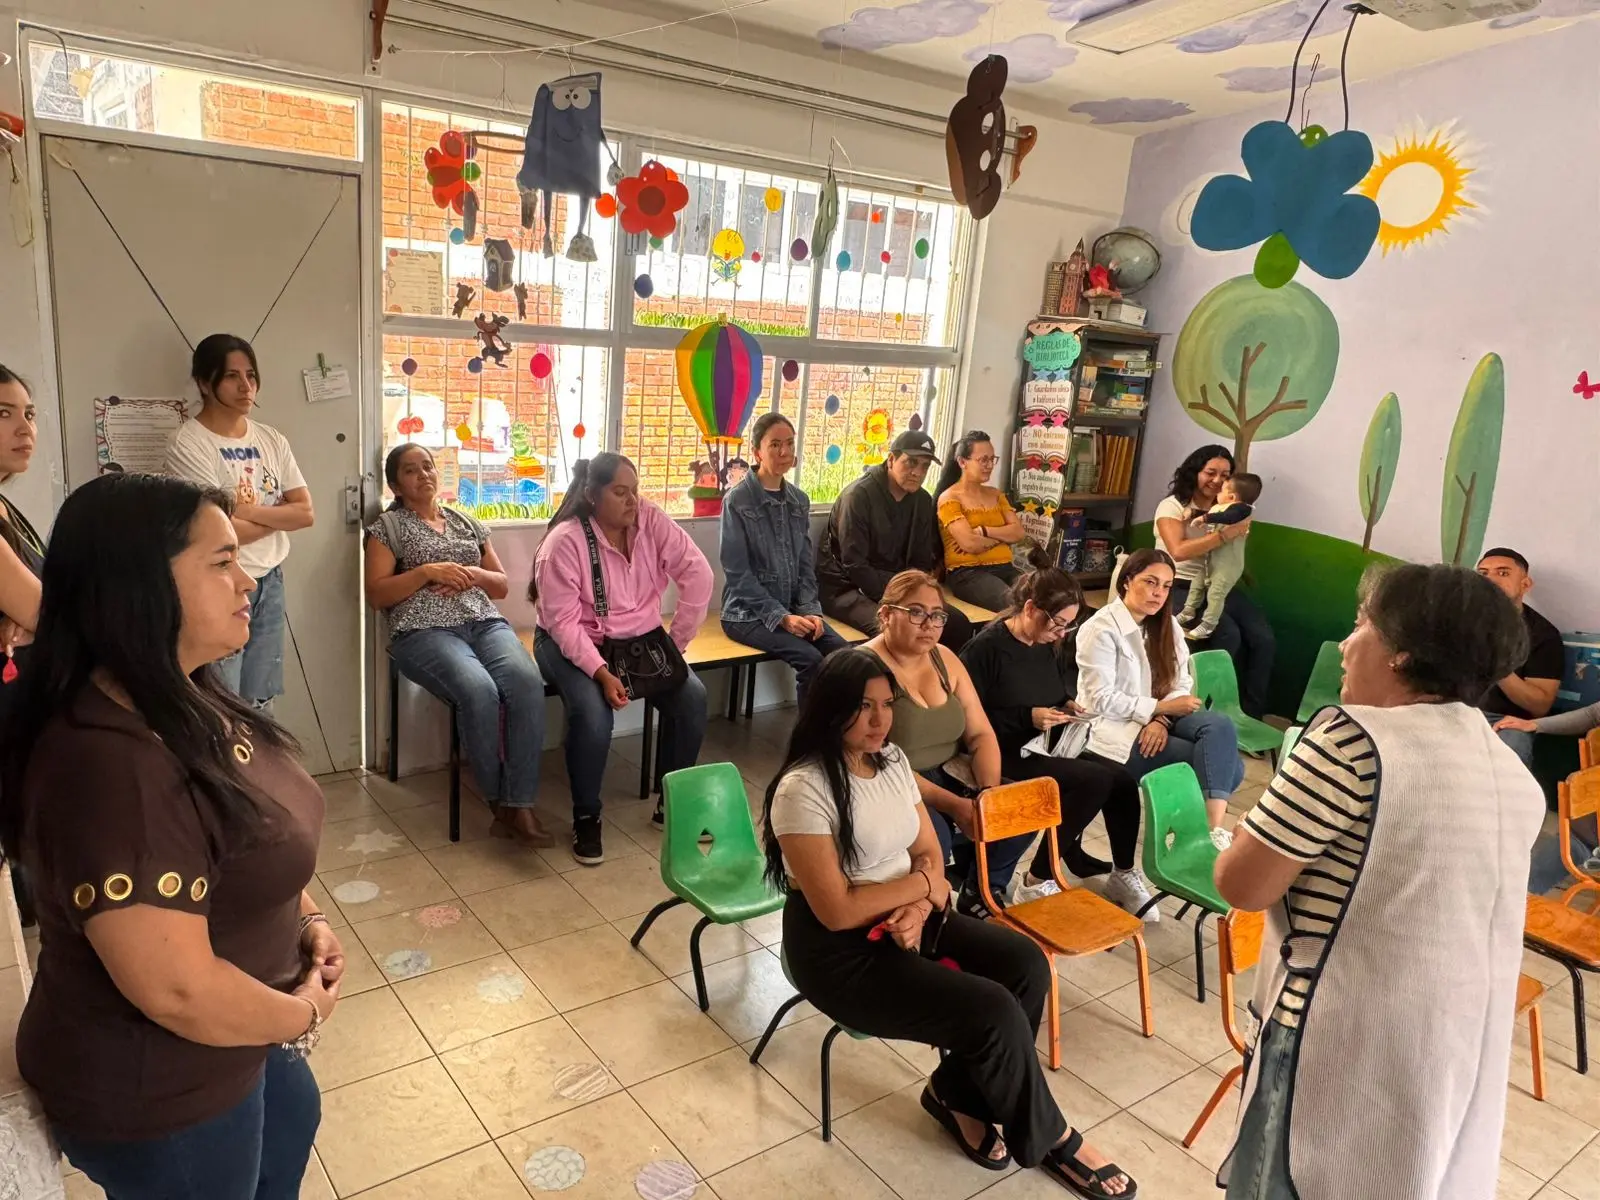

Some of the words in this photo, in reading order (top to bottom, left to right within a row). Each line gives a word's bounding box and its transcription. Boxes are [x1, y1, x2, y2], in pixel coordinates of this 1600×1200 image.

[1036, 339, 1061, 350] REGLAS
[1062, 337, 1071, 349] DE
[1035, 350, 1069, 361] BIBLIOTECA
[1033, 429, 1042, 439] NO
[595, 577, 603, 596] LOLA
